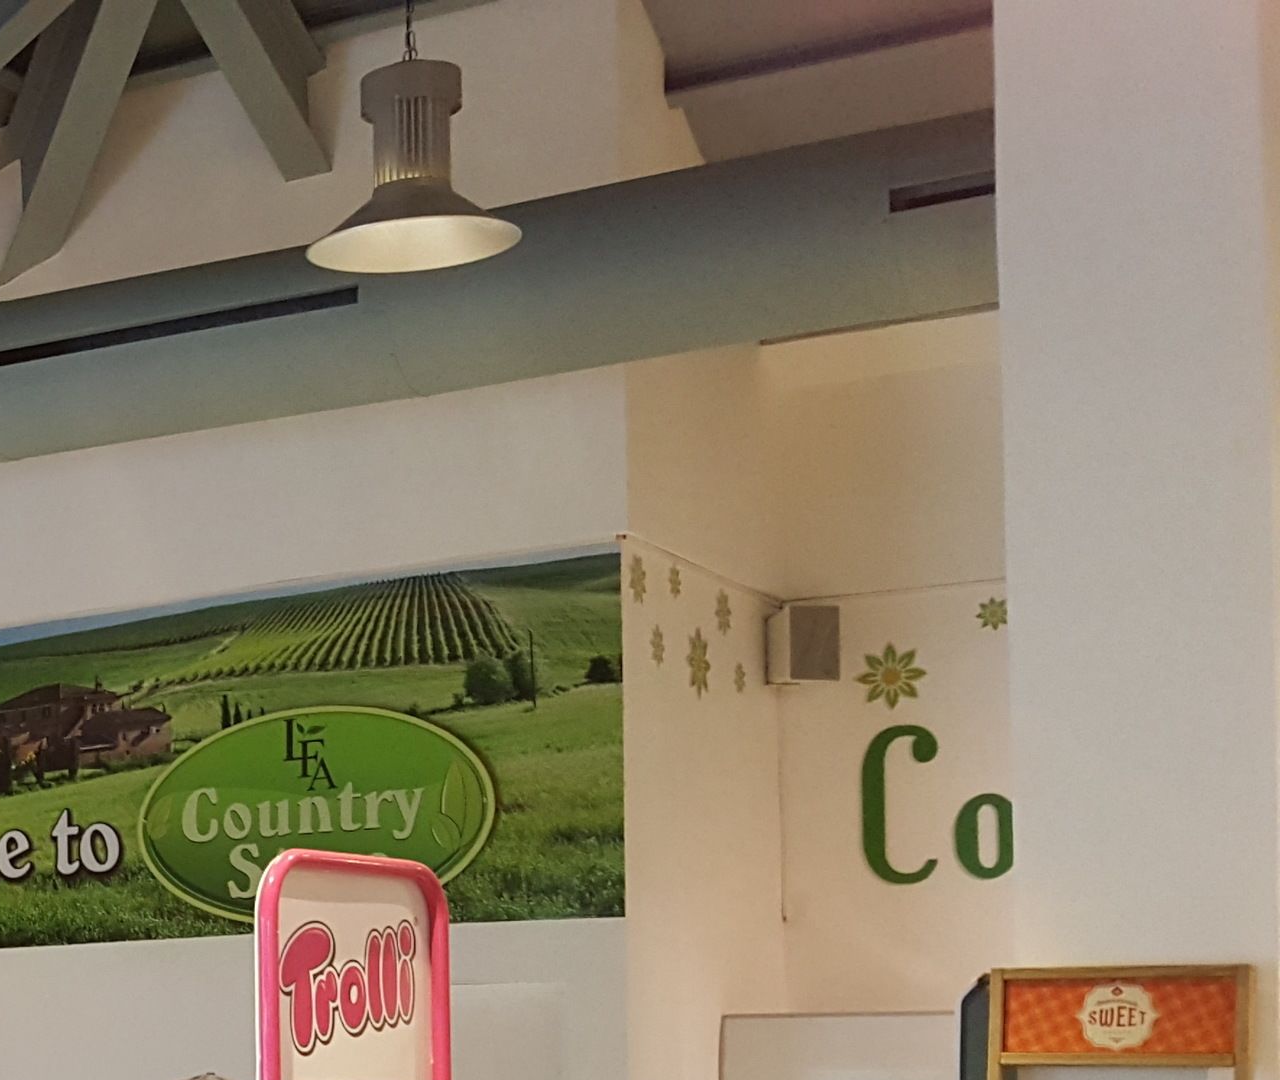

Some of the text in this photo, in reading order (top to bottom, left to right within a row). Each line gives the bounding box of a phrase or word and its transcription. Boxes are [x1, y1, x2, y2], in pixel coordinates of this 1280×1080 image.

[53, 808, 122, 875] to
[181, 781, 425, 842] Country
[278, 919, 417, 1057] Trolli
[1087, 1005, 1147, 1028] SWEET
